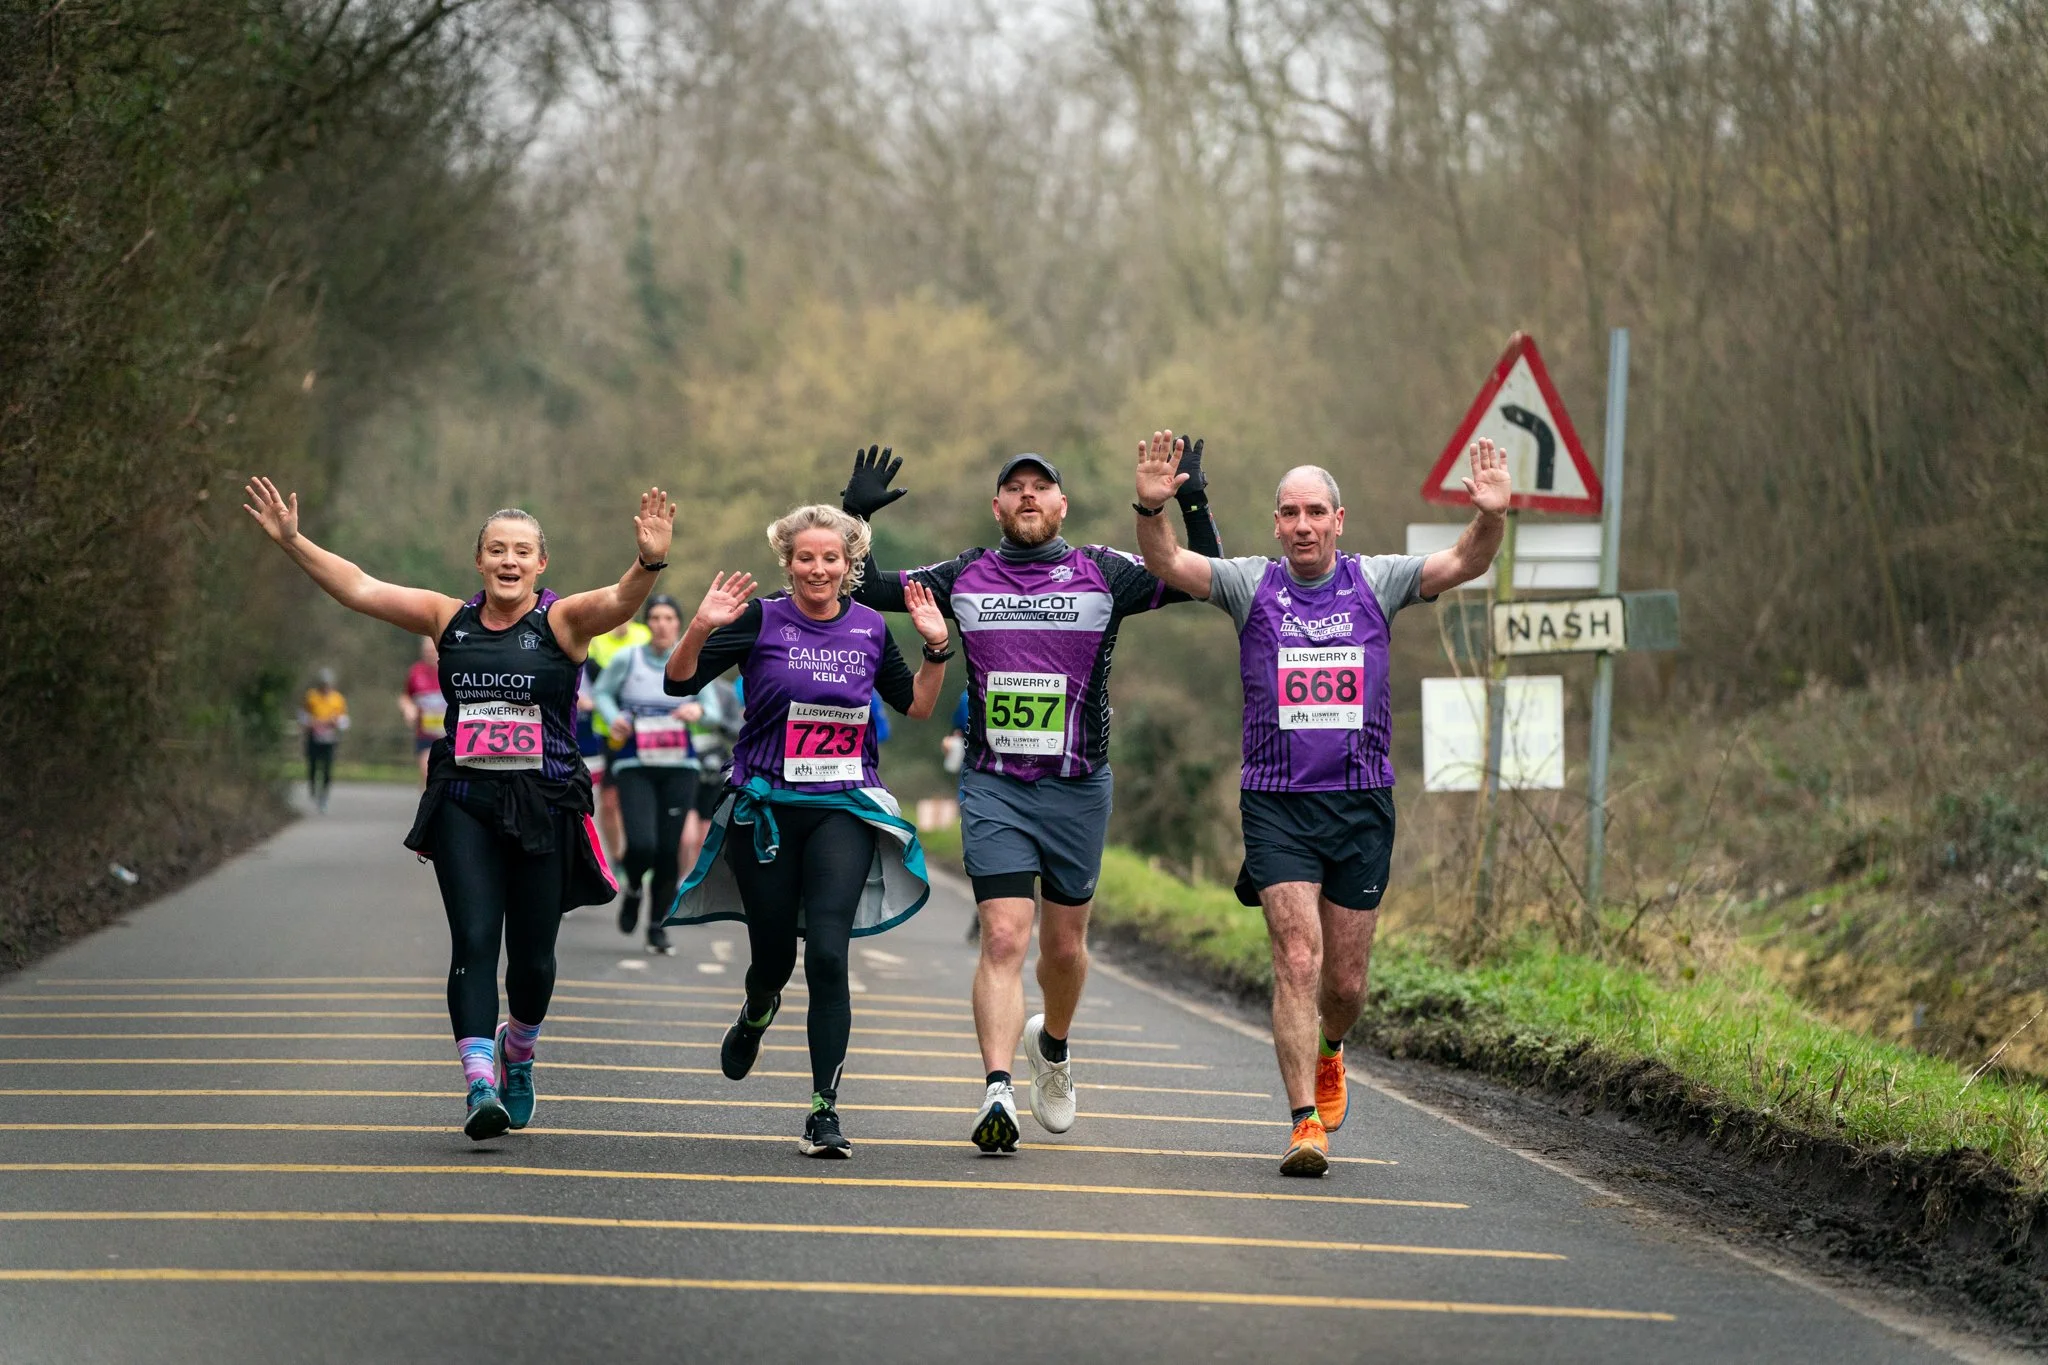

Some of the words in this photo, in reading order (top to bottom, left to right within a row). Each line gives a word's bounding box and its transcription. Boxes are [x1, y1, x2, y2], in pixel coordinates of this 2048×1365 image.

[981, 597, 1077, 610] CALDICOT
[995, 612, 1045, 621] RUNNING
[1046, 612, 1076, 621] CLUB
[1330, 624, 1351, 634] CLUB
[1508, 611, 1610, 641] NASH
[788, 647, 867, 666] CALDICOT
[1286, 652, 1348, 662] LLISWERRY
[1350, 652, 1357, 661] 8
[788, 660, 838, 672] RUNNING
[844, 664, 866, 677] CLUB
[451, 672, 536, 689] CALDICOT
[813, 671, 848, 683] KEILA
[993, 677, 1052, 687] LLISWERRY
[1053, 679, 1060, 688] 8
[1285, 669, 1357, 703] 668
[455, 690, 502, 700] RUNNING
[504, 690, 531, 701] CLUB
[466, 707, 526, 717] LLISWERRY
[528, 709, 535, 717] 8
[796, 708, 857, 720] LLISWERRY
[857, 711, 864, 720] 8
[991, 694, 1060, 729] 557
[463, 722, 536, 753] 756
[793, 723, 859, 756] 723
